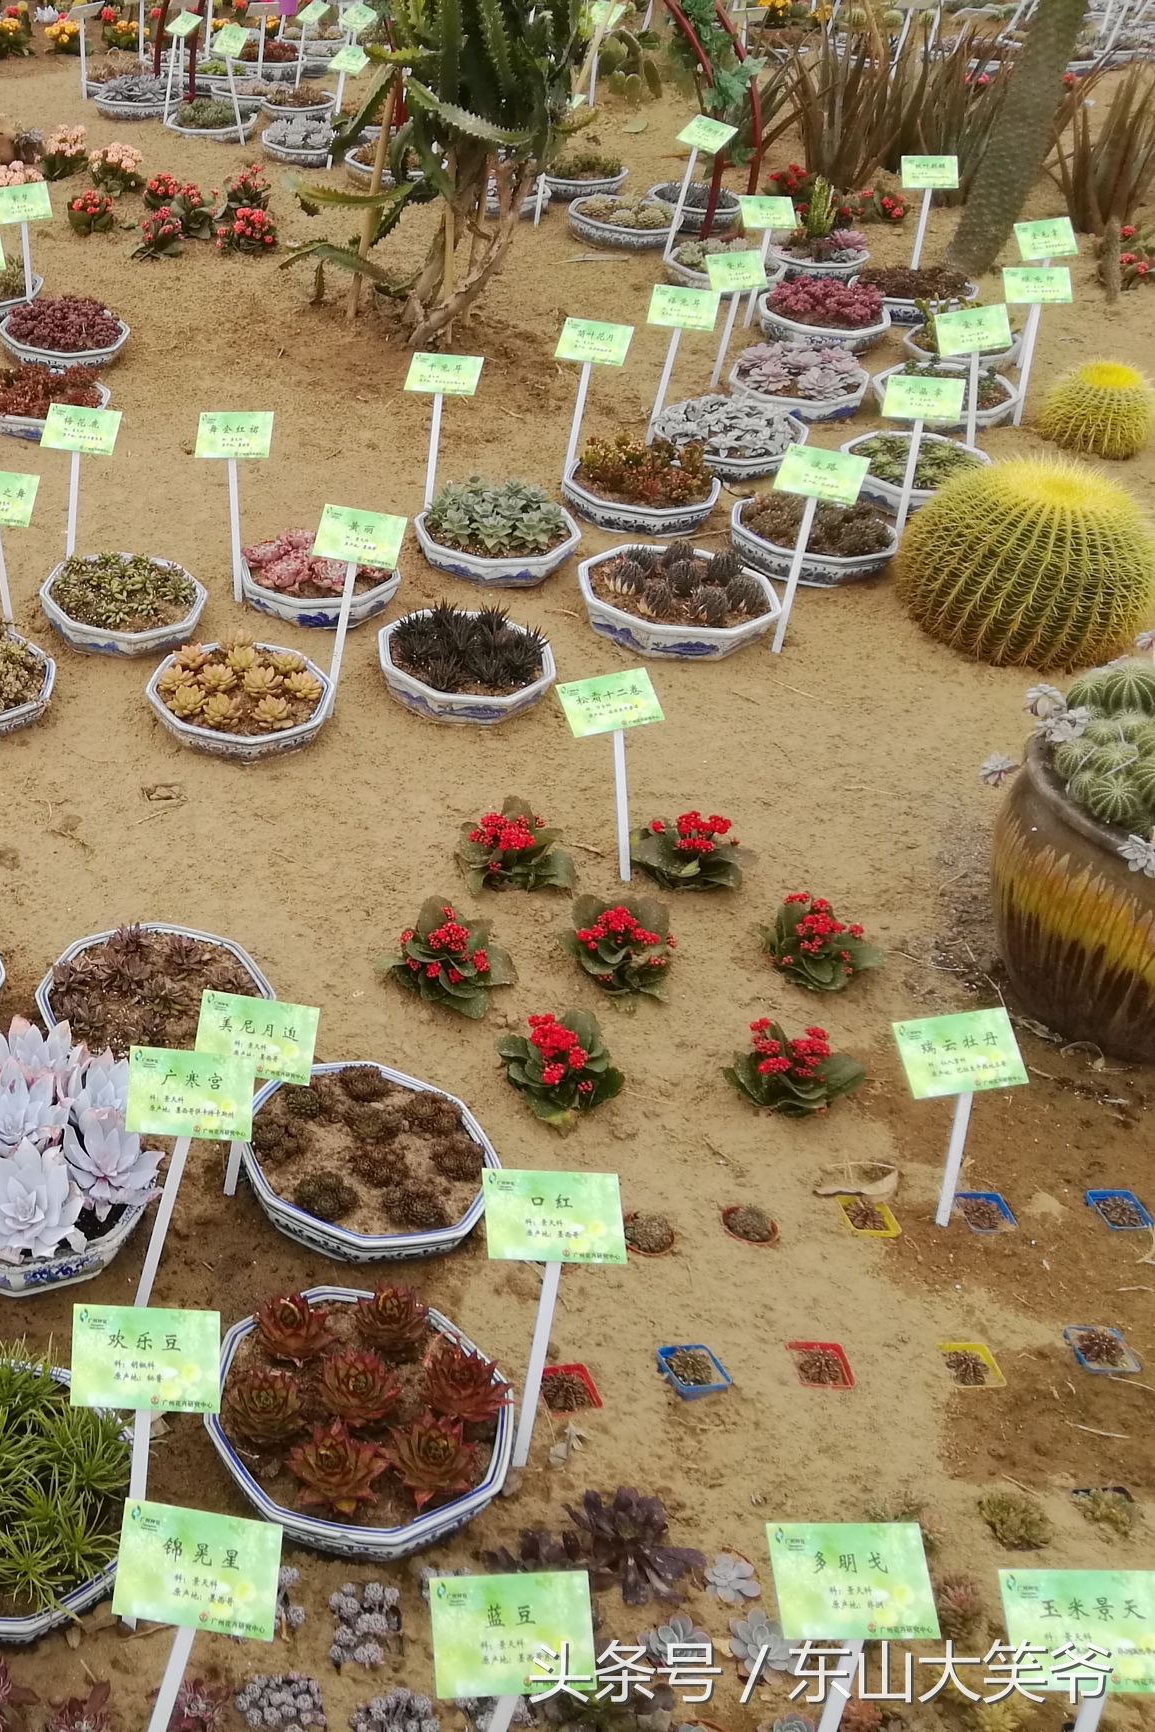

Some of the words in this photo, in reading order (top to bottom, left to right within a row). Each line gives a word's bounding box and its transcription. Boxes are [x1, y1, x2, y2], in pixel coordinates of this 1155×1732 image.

[218, 1016, 299, 1042] 美尼月迫
[920, 1030, 999, 1055] 瑞云牡丹
[161, 1068, 223, 1091] 广寒宫
[531, 1194, 574, 1209] 口红
[108, 1330, 182, 1352] 欢乐豆
[162, 1536, 241, 1571] 锦晃星
[814, 1550, 889, 1576] 多明戈
[485, 1603, 537, 1629] 蓝豆
[1040, 1596, 1147, 1622] 玉米景天
